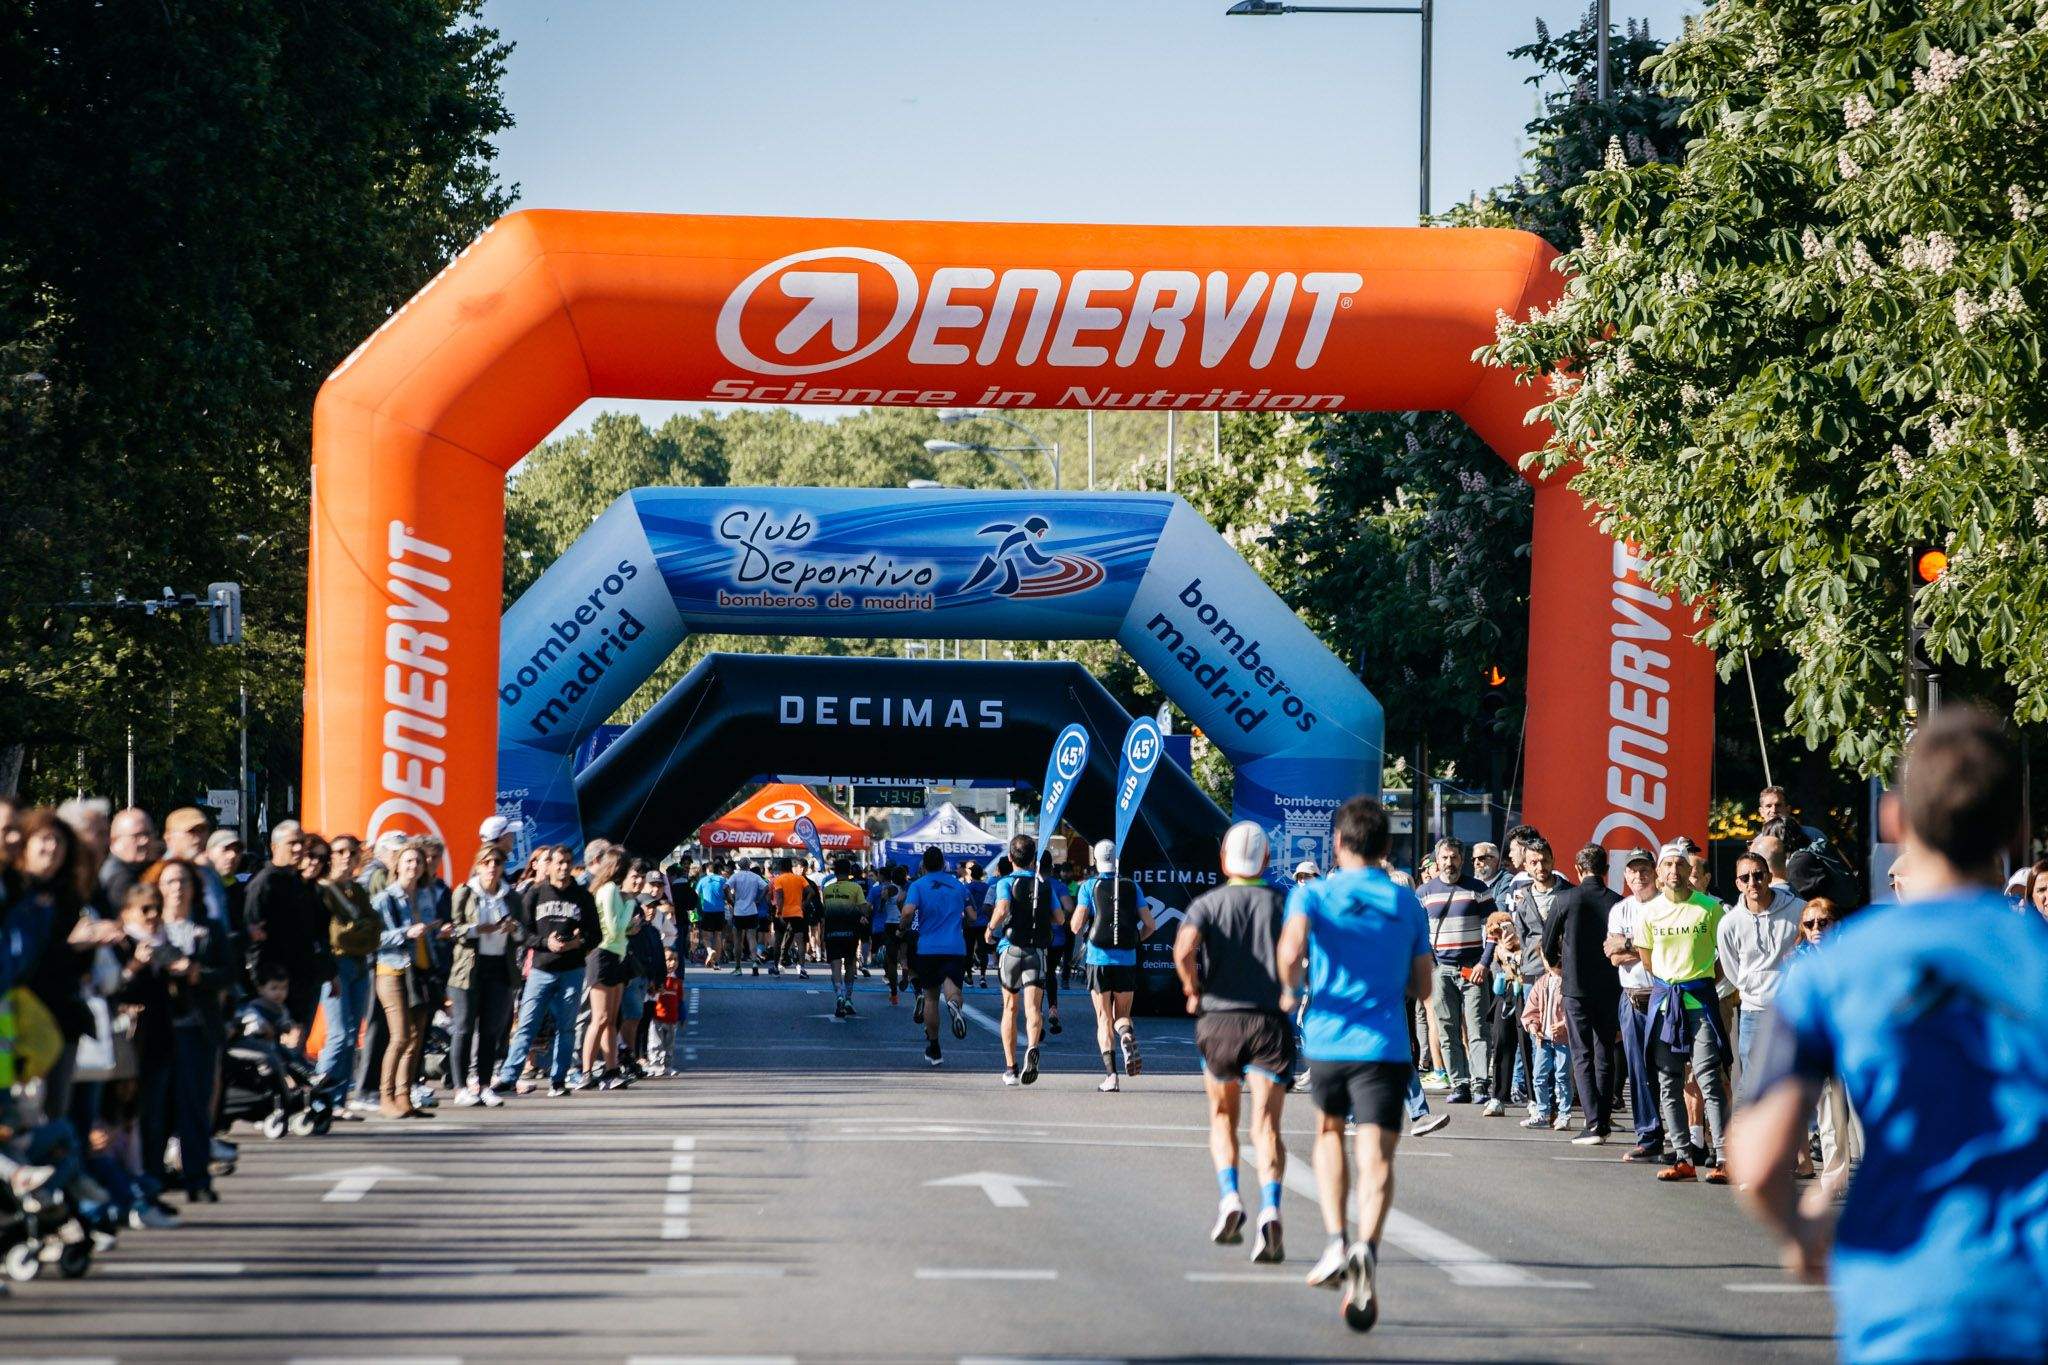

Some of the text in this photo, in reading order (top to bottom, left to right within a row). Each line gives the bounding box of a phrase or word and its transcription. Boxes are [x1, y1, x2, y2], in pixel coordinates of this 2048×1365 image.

[908, 267, 1364, 370] ENERVIT
[706, 379, 1346, 409] Science in Nutrition
[720, 511, 811, 543] Club
[738, 540, 932, 593] Deportivo
[720, 591, 933, 610] bomberos de madrid
[498, 557, 638, 707] bomberos
[382, 519, 452, 806] ENERVIT
[528, 608, 646, 736] madrid
[1178, 577, 1318, 733] bomberos
[1146, 612, 1269, 734] madrid
[1606, 540, 1674, 821] ENERVIT
[780, 695, 1004, 729] DECIMAS
[1060, 746, 1084, 766] 45'
[1131, 738, 1155, 760] 45'
[496, 788, 530, 799] eros
[1045, 780, 1064, 814] sub
[1120, 775, 1138, 811] sub
[1274, 793, 1342, 808] bomberos
[728, 831, 775, 844] ENERVIT
[1133, 870, 1218, 885] DECIMAS
[1653, 924, 1708, 936] DECIMAS
